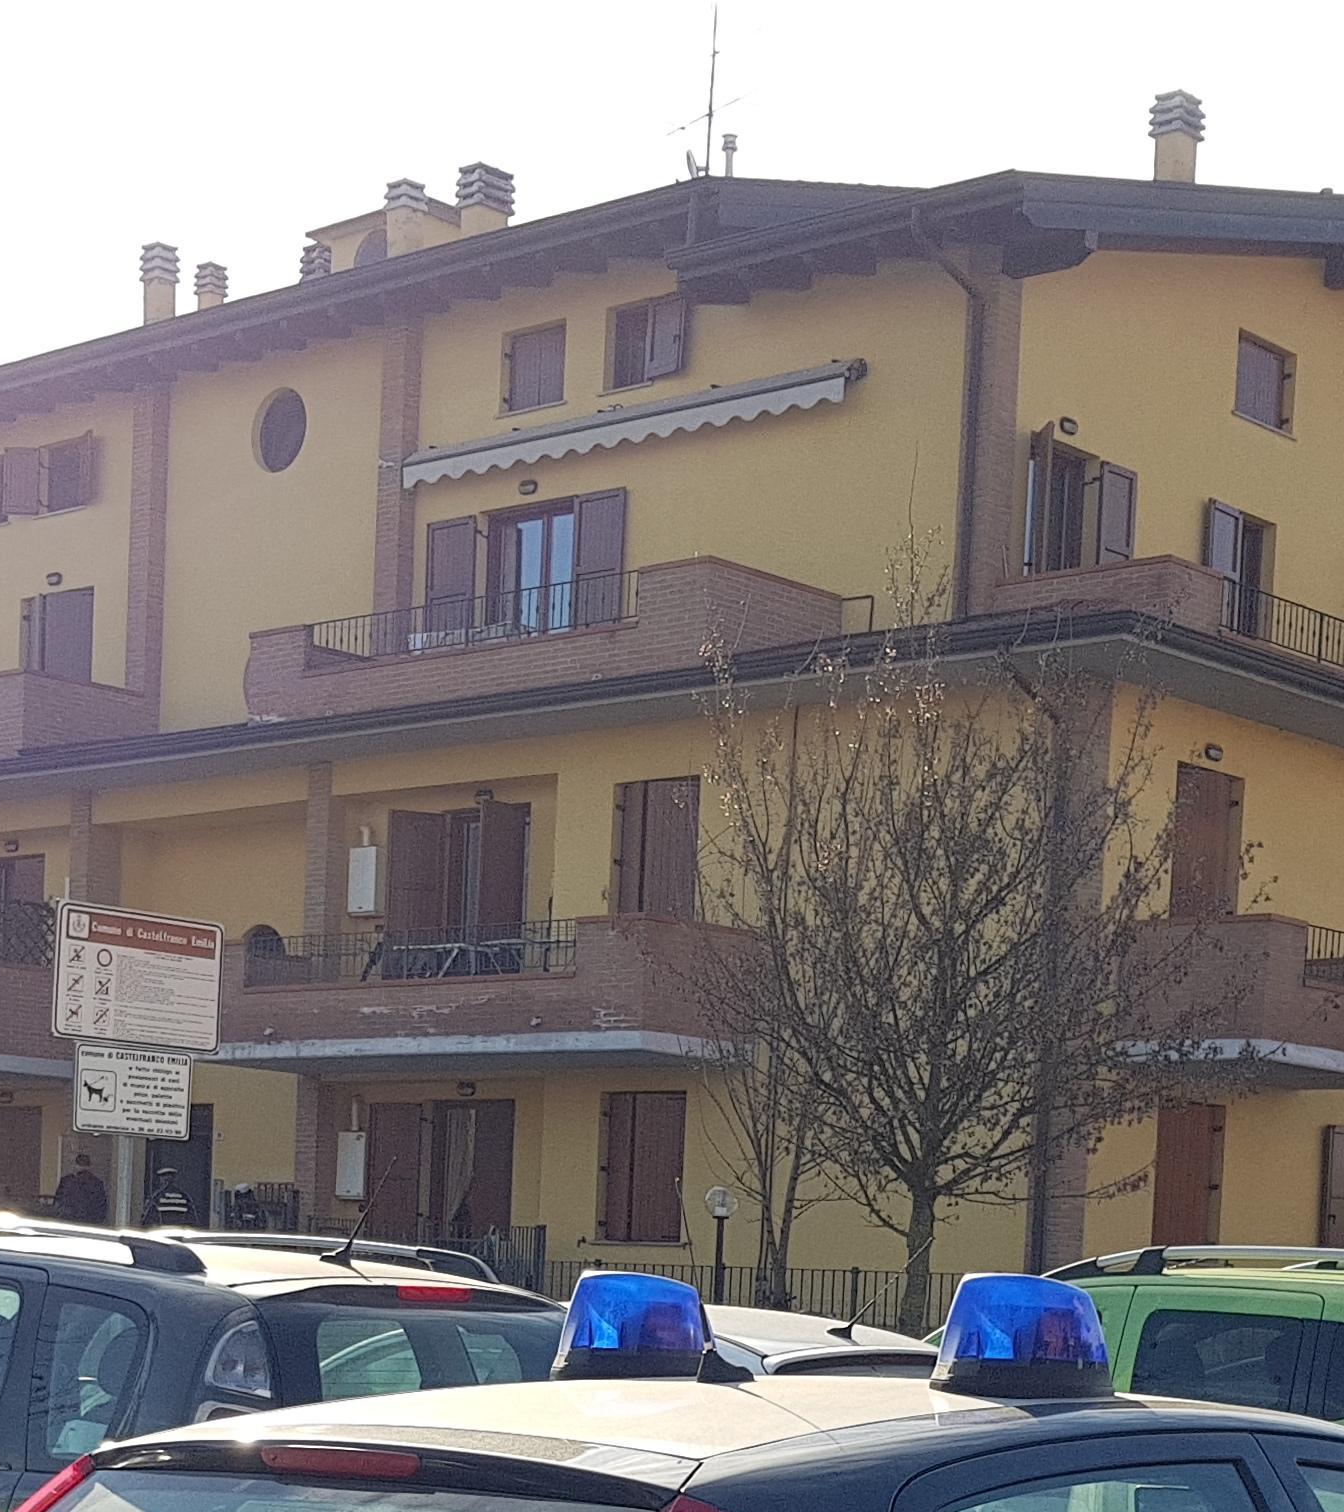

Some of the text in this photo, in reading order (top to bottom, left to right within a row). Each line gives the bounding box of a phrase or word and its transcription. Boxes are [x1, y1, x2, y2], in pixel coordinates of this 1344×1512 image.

[137, 928, 188, 945] Castelfranco
[191, 935, 215, 950] Emilia
[116, 1051, 165, 1065] CASTELFRANCO
[167, 1055, 188, 1066] EMILIA
